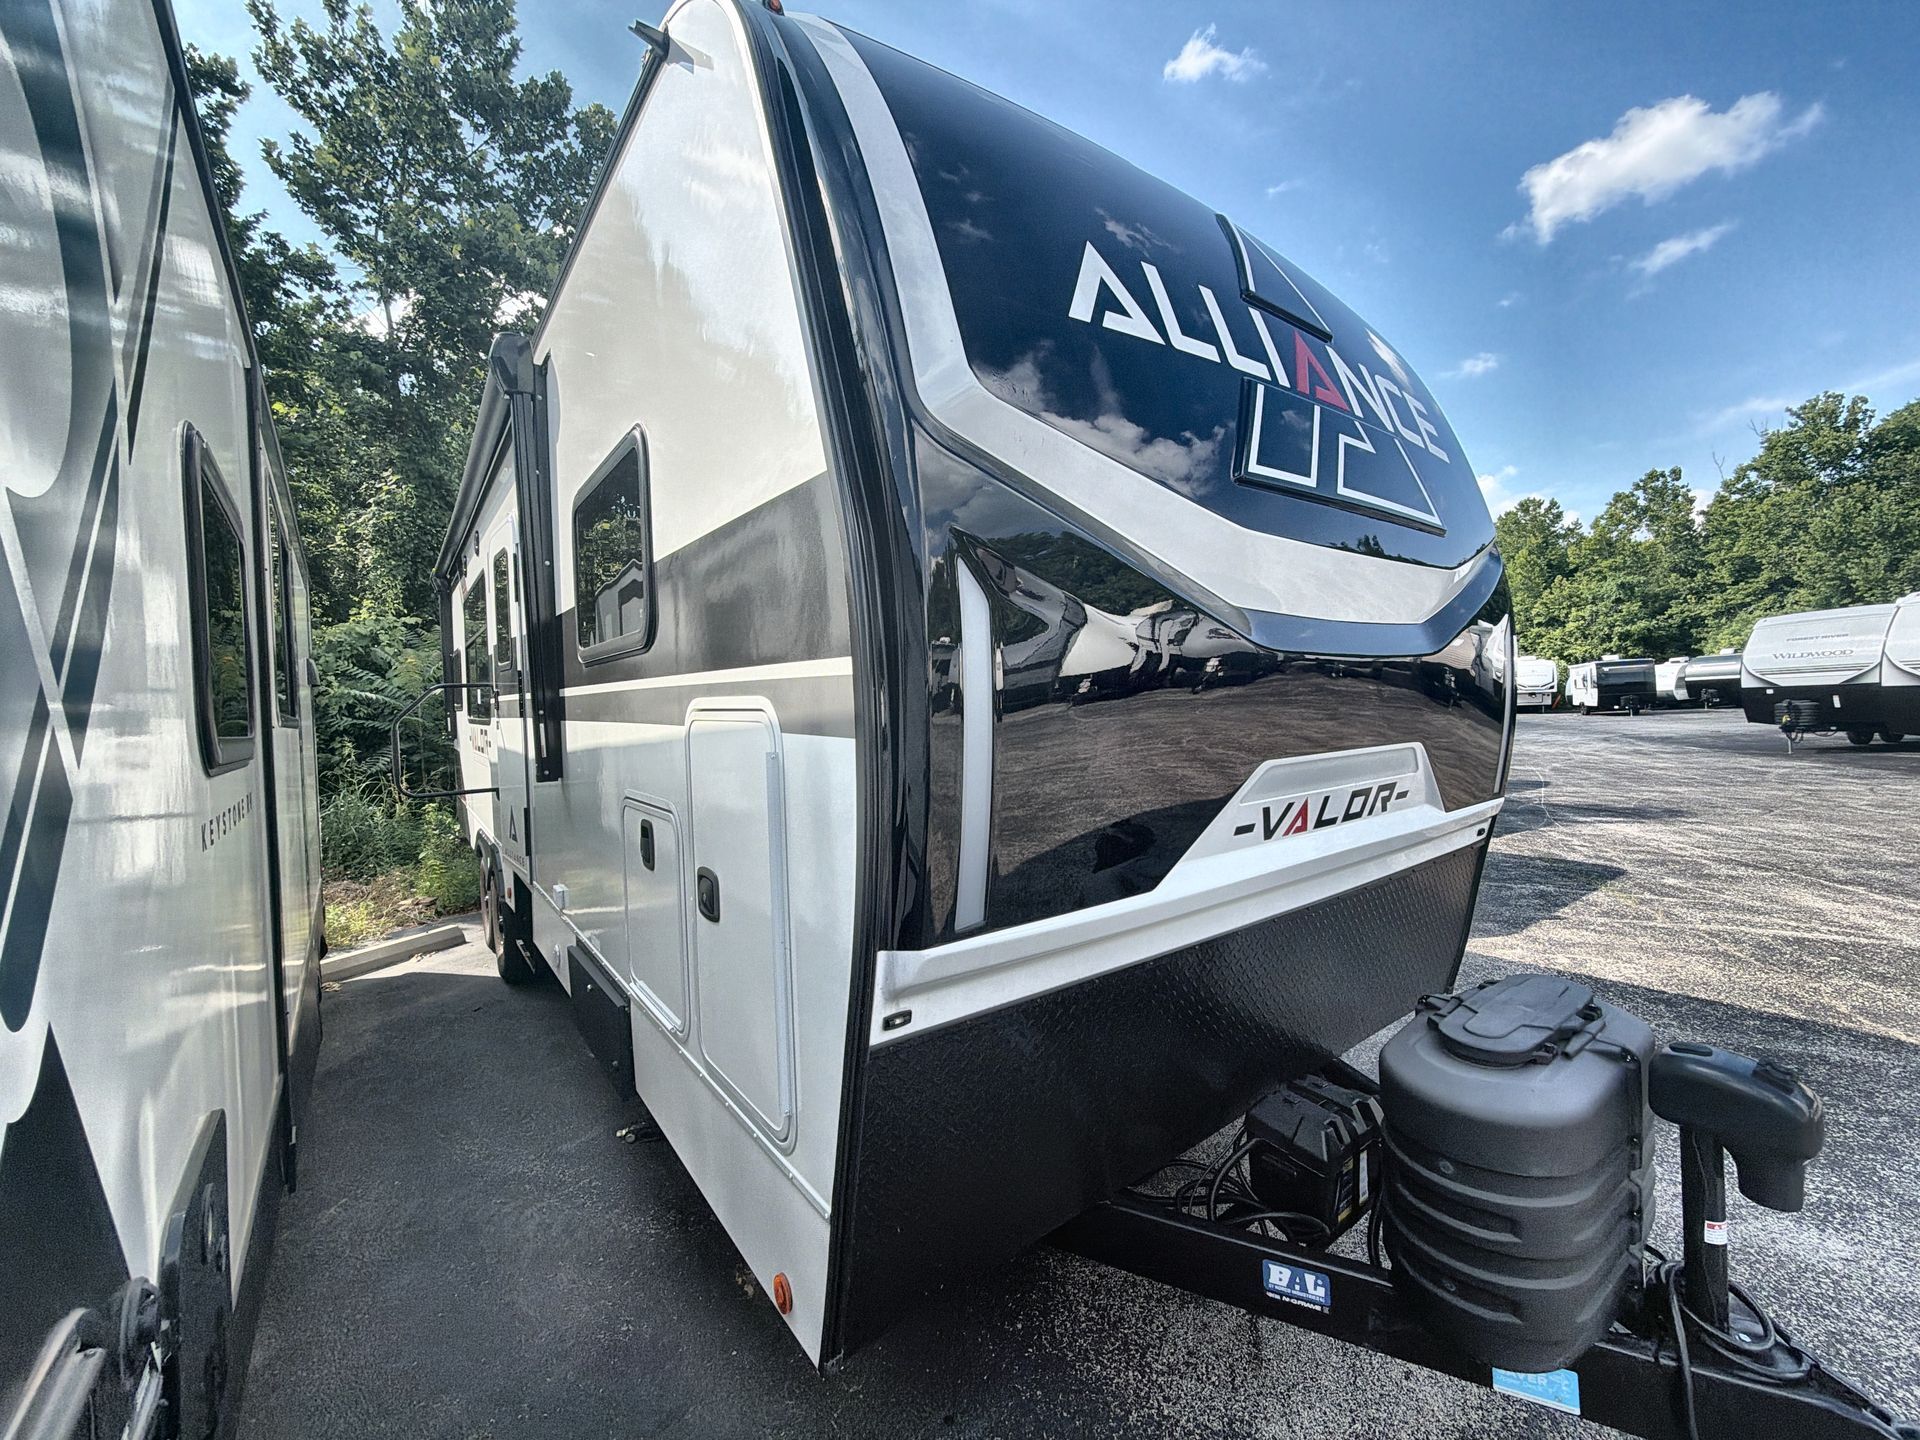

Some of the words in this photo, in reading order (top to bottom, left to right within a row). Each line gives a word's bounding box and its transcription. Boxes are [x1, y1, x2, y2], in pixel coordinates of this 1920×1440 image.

[1068, 240, 1450, 464] ALLIANCE
[1772, 649, 1854, 660] WILDWOOD
[201, 798, 245, 853] KEYSTONE
[1268, 1263, 1326, 1297] BAL
